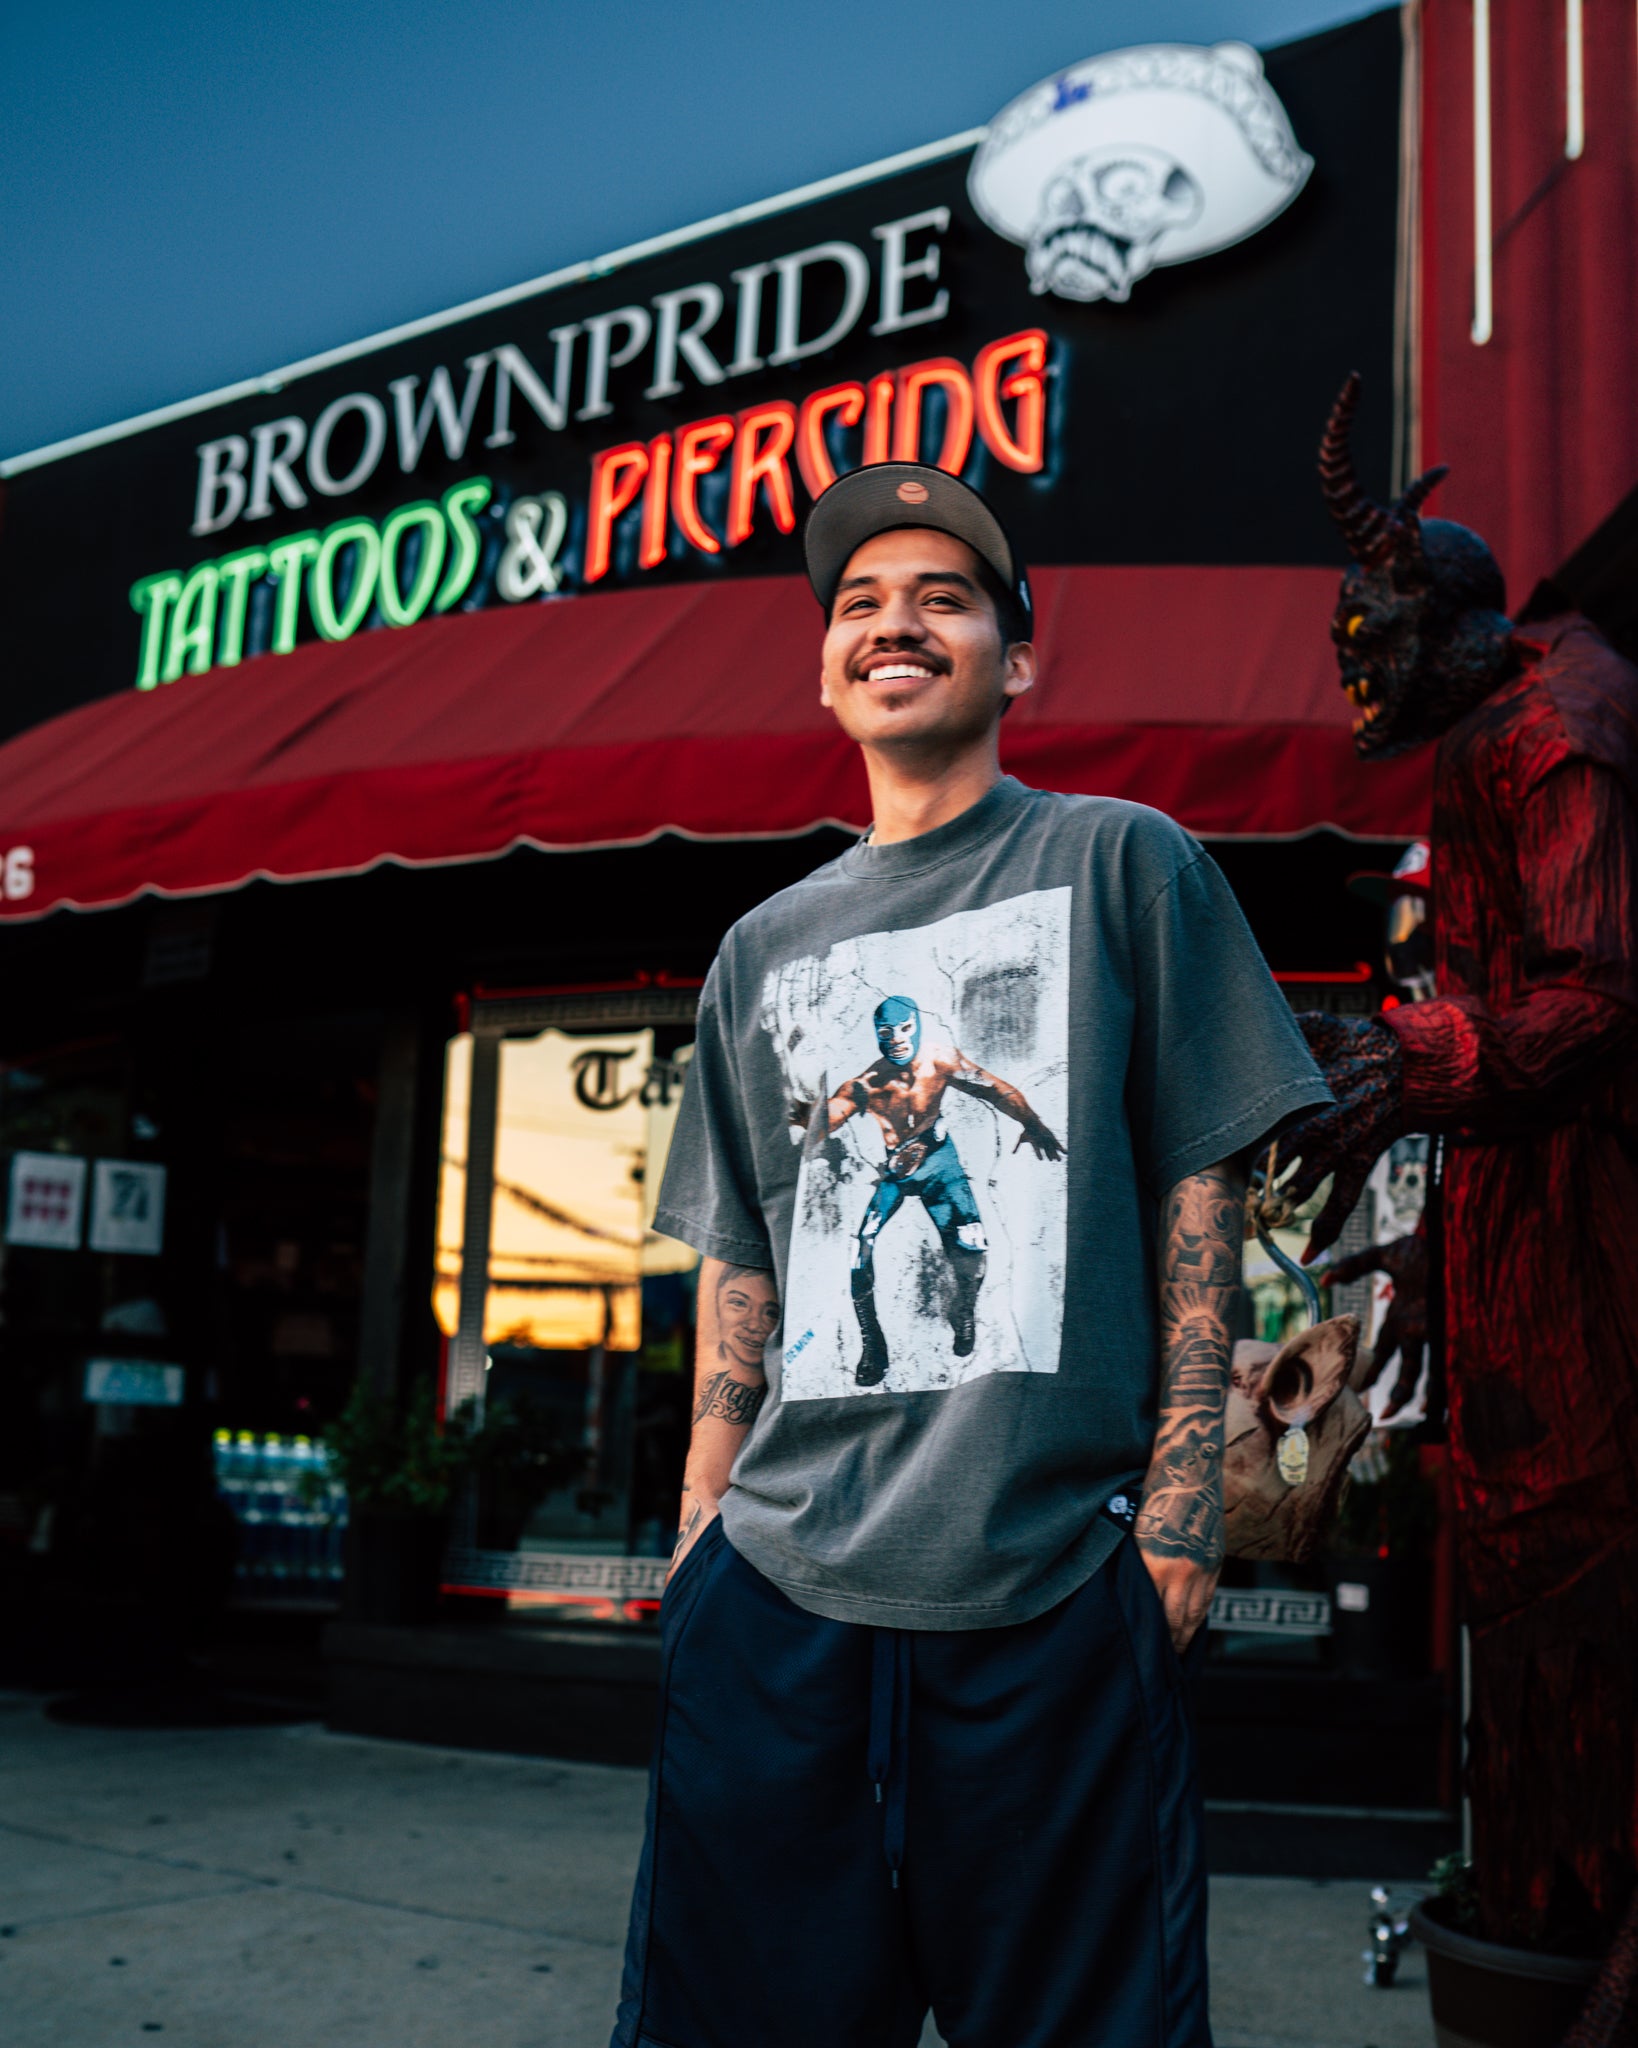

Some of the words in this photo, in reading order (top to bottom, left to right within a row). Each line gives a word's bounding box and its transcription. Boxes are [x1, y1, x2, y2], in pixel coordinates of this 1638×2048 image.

[130, 476, 492, 691] TATTOOS
[496, 491, 567, 603] &
[584, 328, 1048, 583] PIERCING
[191, 206, 950, 537] BROWNPRIDE
[0, 844, 36, 901] 6
